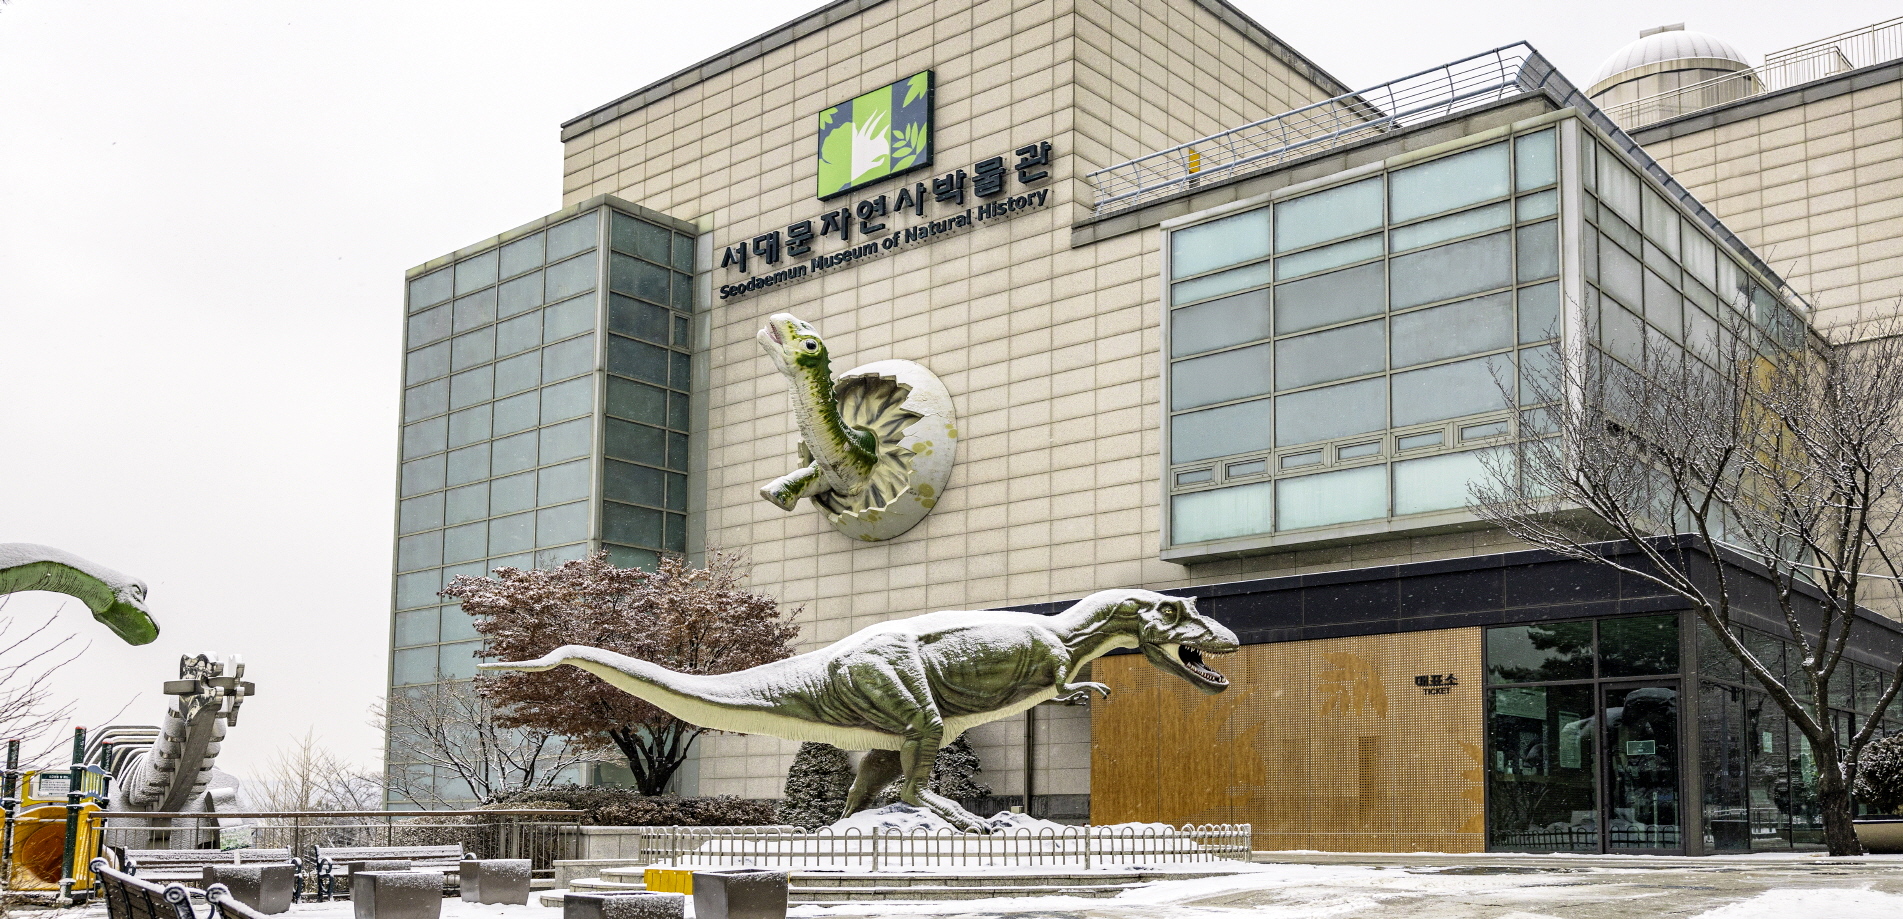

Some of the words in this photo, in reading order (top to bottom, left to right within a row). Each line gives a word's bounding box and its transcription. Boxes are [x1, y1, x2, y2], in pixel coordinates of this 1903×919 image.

[720, 141, 1052, 273] 서대문자연사박물관
[719, 262, 807, 300] Seodaemun
[811, 241, 878, 273] Museum
[882, 231, 900, 250] of
[905, 209, 972, 243] Natural
[977, 189, 1050, 221] History
[1415, 673, 1459, 687] 매표소
[1423, 687, 1450, 695] TICKET
